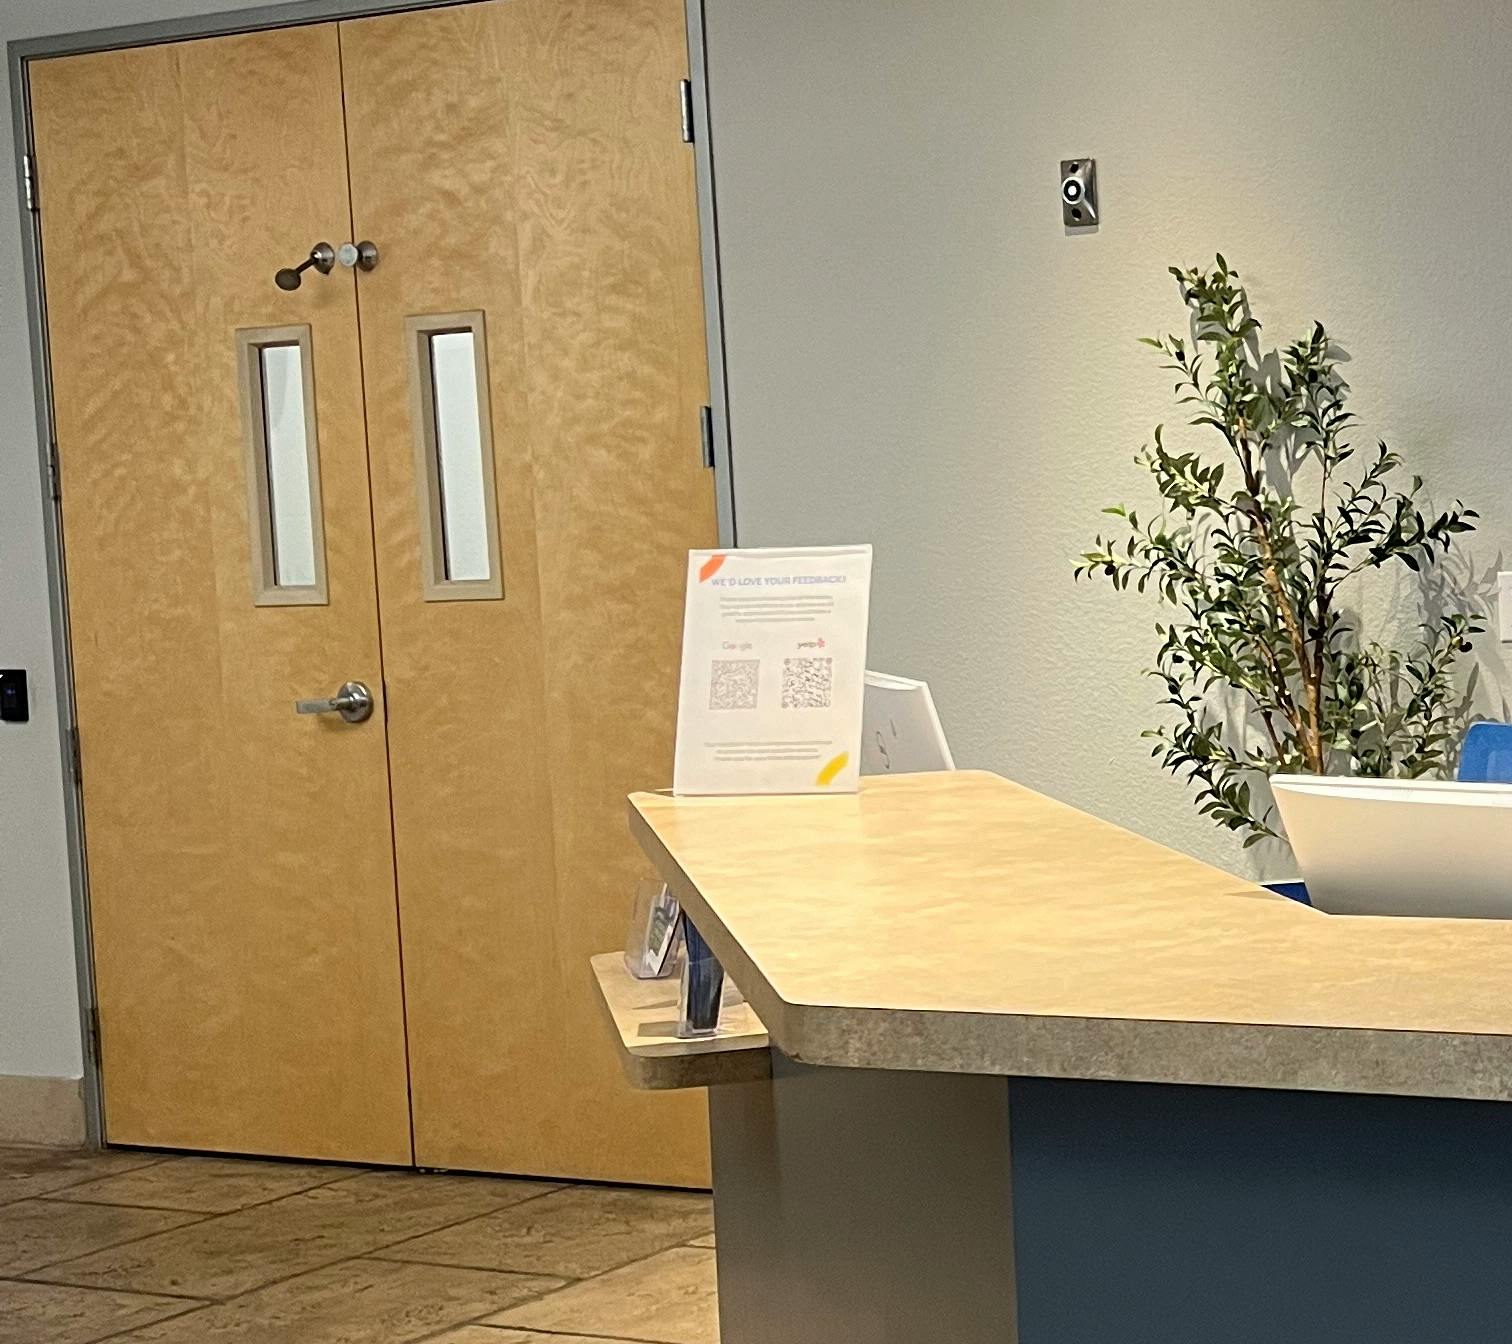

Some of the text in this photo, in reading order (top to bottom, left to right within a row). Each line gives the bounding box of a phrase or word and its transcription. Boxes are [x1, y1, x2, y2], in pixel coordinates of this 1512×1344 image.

[738, 576, 763, 586] LOVE
[763, 575, 791, 586] YOUR
[722, 640, 753, 652] Gogle
